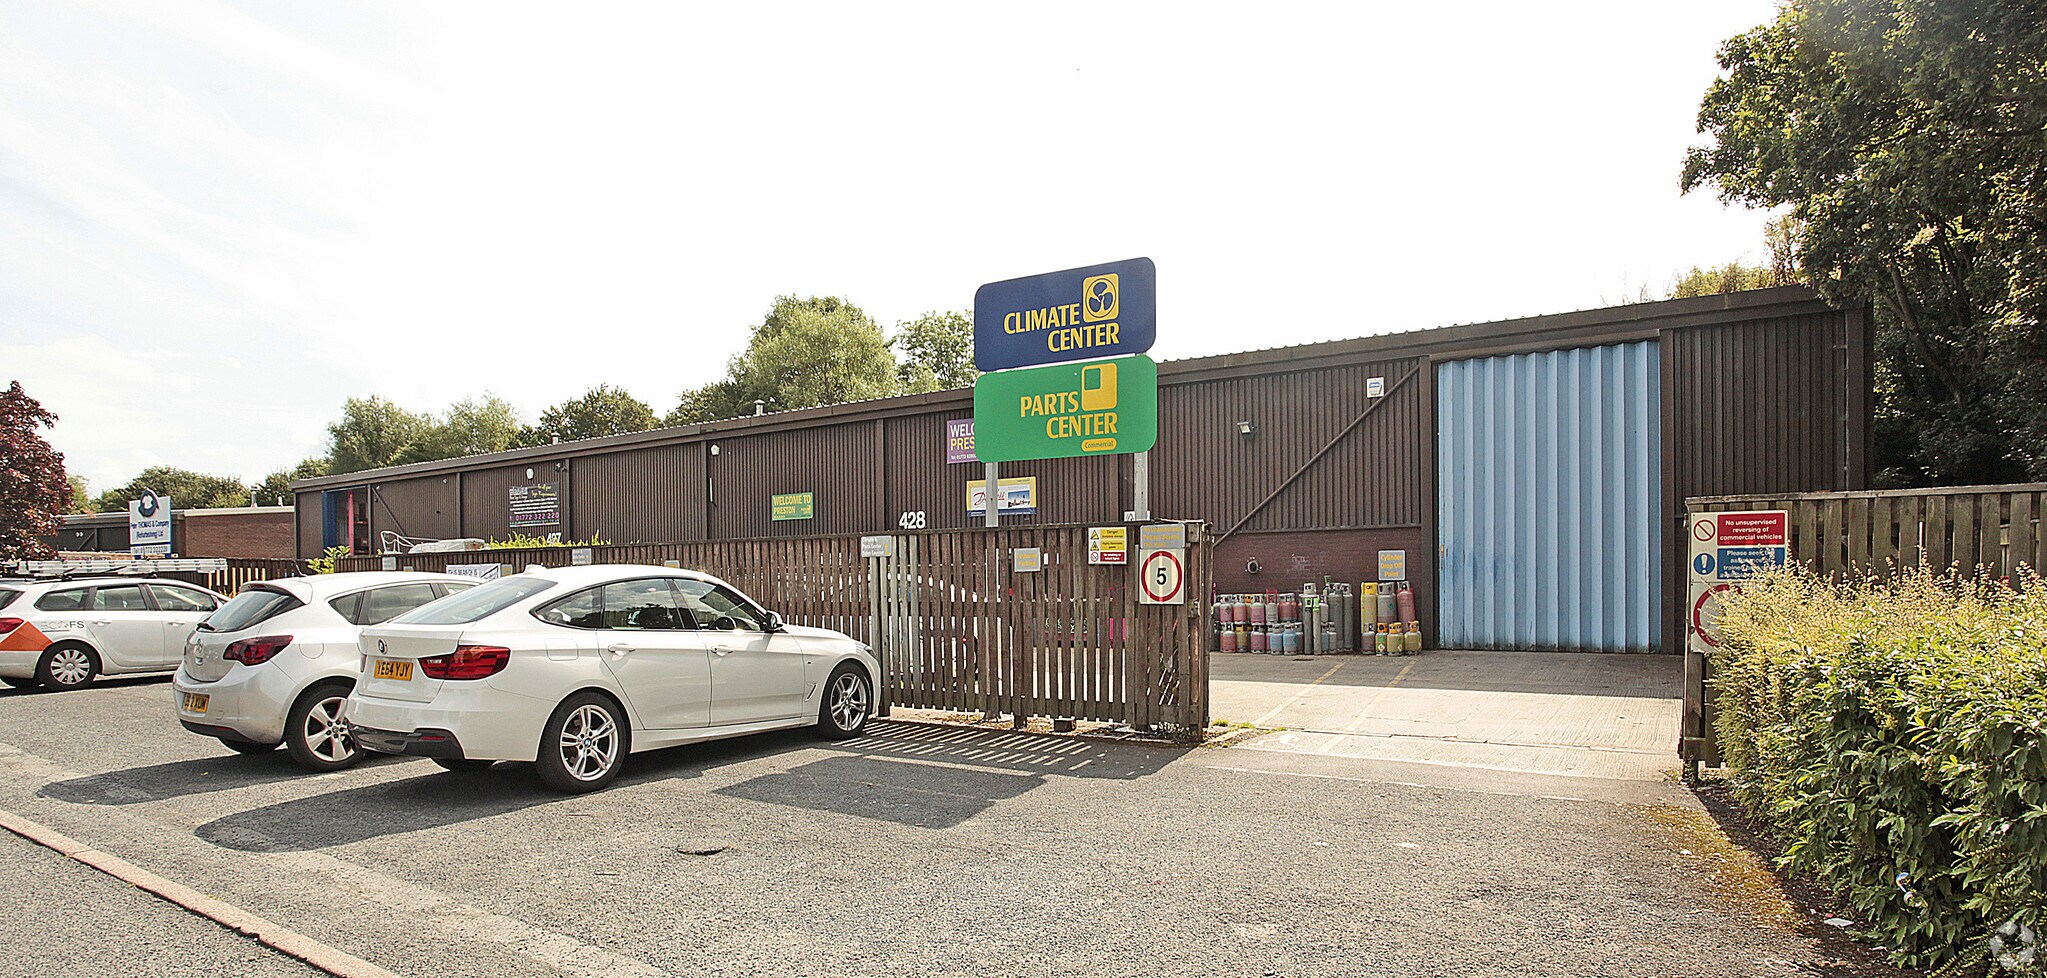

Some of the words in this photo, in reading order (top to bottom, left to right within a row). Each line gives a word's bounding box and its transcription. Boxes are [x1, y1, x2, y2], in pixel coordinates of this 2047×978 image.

[1003, 303, 1080, 335] CLIMATE
[1047, 322, 1120, 352] CENTER
[1020, 391, 1079, 418] PARTS
[1046, 412, 1118, 439] CENTER
[1084, 440, 1114, 449] Commercial
[773, 495, 803, 506] WELCOME
[803, 494, 811, 504] TO
[773, 505, 796, 515] PRESTON
[899, 511, 926, 529] 428
[1735, 519, 1777, 527] unsupervised
[1156, 567, 1167, 585] 5
[377, 661, 395, 676] YE64
[395, 663, 410, 677] YJY
